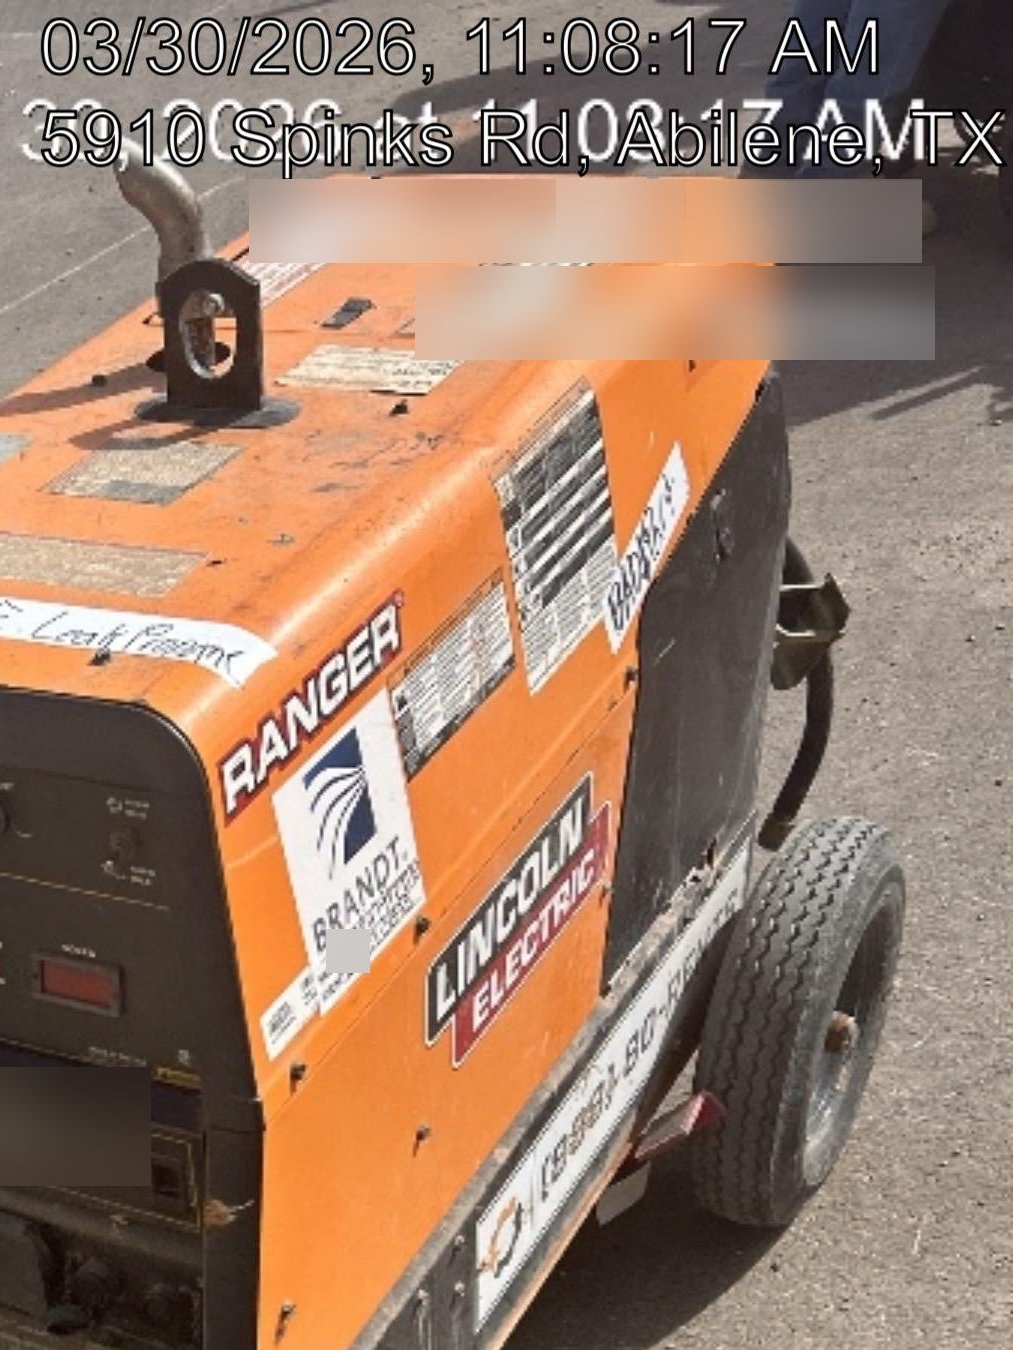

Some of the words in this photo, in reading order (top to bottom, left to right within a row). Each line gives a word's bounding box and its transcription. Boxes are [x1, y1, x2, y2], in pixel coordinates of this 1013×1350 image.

[219, 602, 402, 815] RANGER
[310, 835, 404, 951] BRANDT
[435, 793, 586, 1023] LINCOLN
[471, 849, 596, 1032] ELECTRIC
